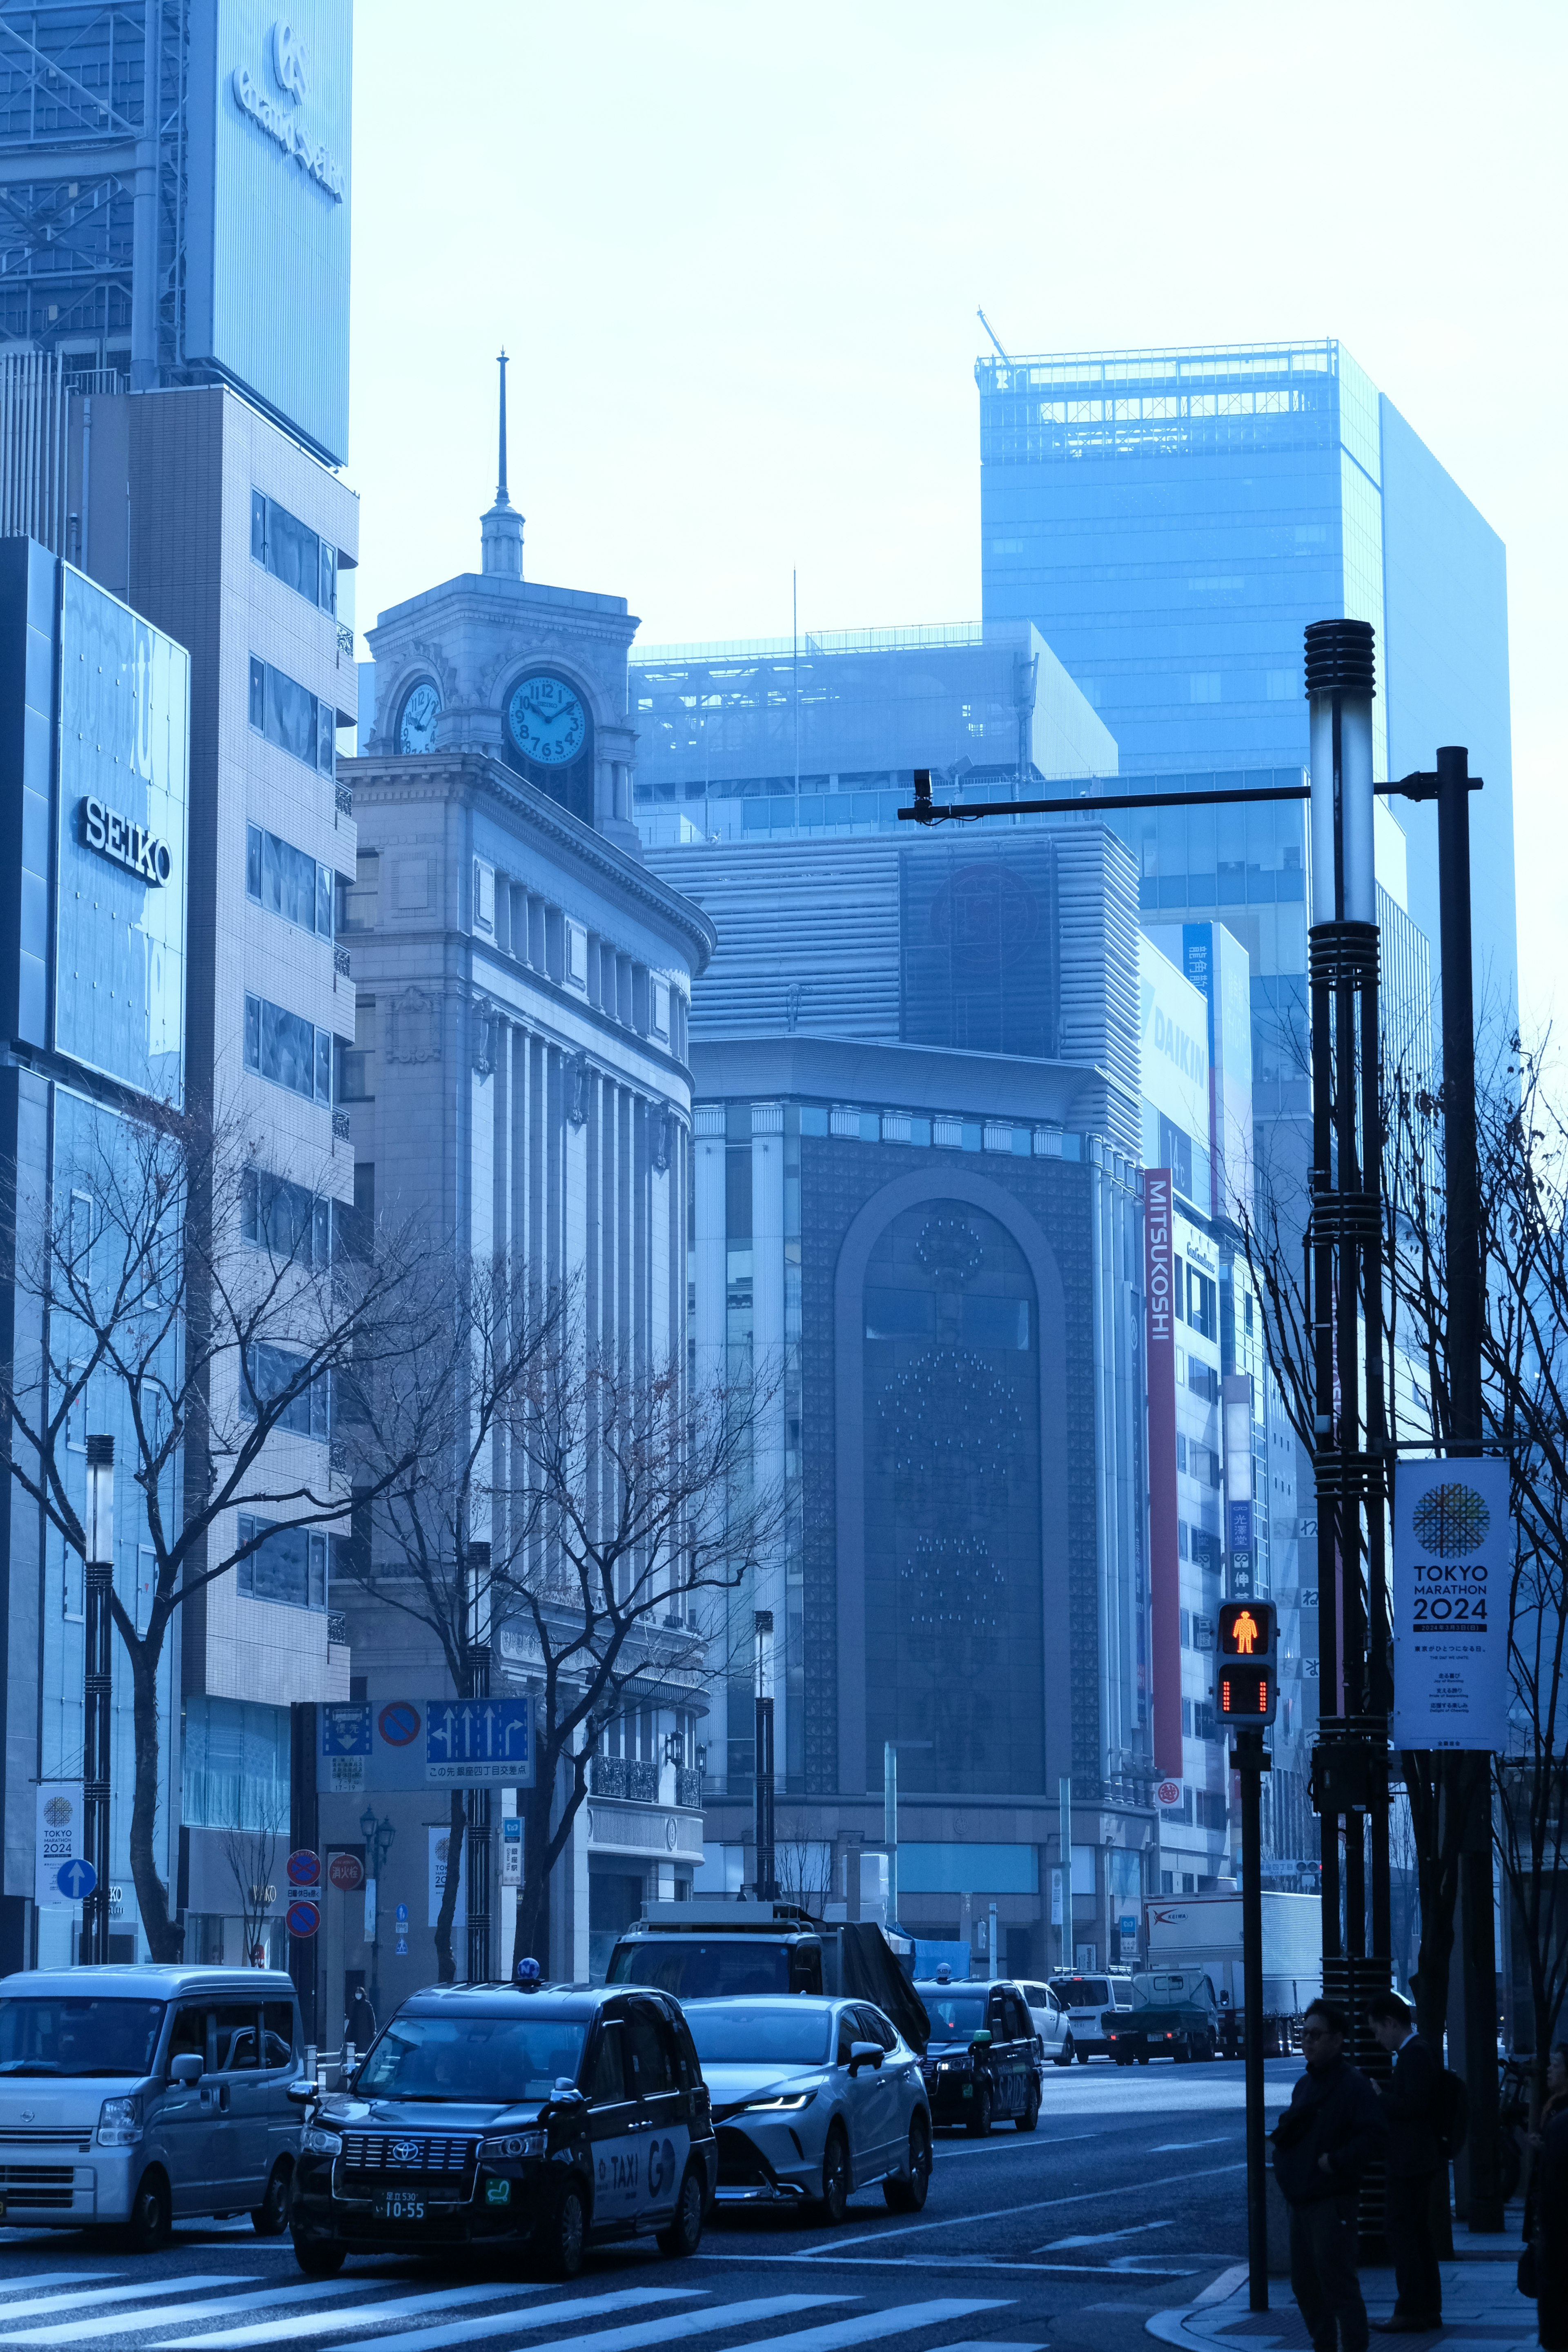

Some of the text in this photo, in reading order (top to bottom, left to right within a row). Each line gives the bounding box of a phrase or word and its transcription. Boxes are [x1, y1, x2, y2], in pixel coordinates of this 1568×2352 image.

[233, 62, 346, 204] Grand Seiko
[531, 686, 539, 699] 11
[542, 684, 553, 698] 12
[558, 690, 562, 703] 1
[520, 696, 530, 710] 10
[538, 701, 557, 709] SEIKO
[515, 710, 524, 723] 9
[572, 717, 579, 732] 3
[520, 725, 529, 739] 8
[565, 732, 575, 746] 4
[531, 737, 540, 751] 7
[542, 743, 551, 757] 6
[555, 740, 564, 755] 5
[84, 796, 173, 888] SEIKO
[1154, 1005, 1204, 1089] DAIKIN
[1149, 1180, 1169, 1340] MITSUKOSHI
[1234, 1514, 1247, 1546] 光澤堂
[1414, 1565, 1488, 1581] TOKYO
[1414, 1585, 1487, 1595] MARATHON
[1413, 1598, 1488, 1620] 2024
[336, 1723, 359, 1734] 優先
[430, 1765, 526, 1776] この先 銀座四丁目交差点
[44, 1844, 71, 1853] 2024
[332, 1866, 358, 1879] 消火栓
[611, 2153, 638, 2191] TAXI
[386, 2192, 416, 2201] 足立 530
[386, 2201, 424, 2218] 10-55
